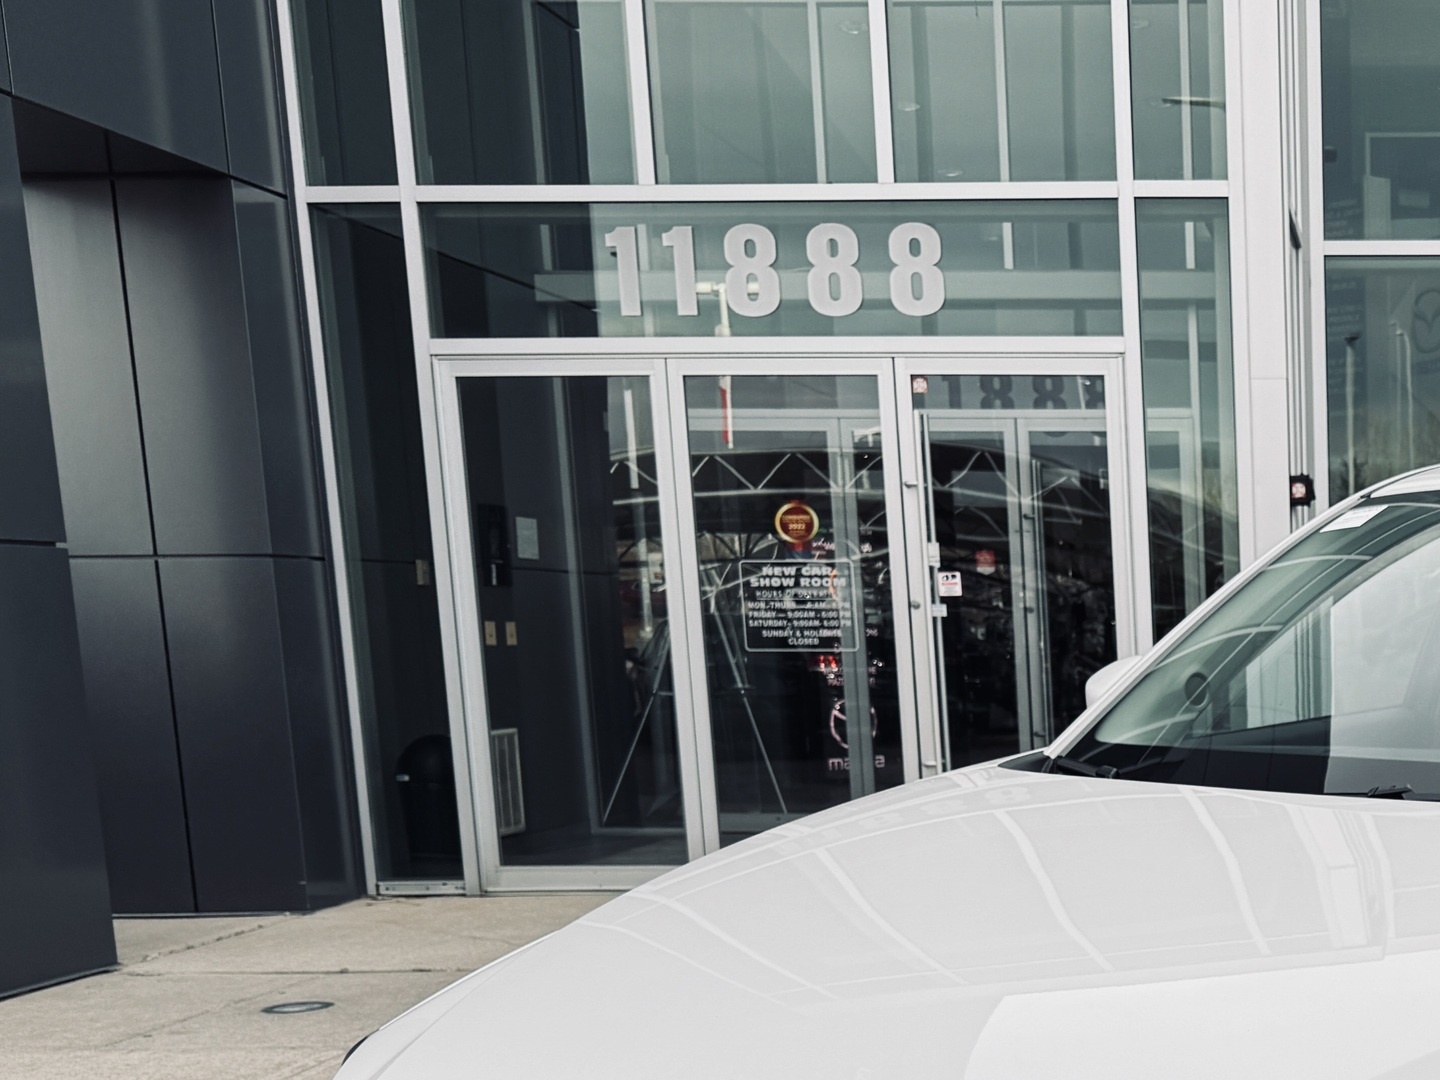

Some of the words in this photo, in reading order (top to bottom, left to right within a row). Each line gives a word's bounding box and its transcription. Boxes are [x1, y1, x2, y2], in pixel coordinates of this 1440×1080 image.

[605, 222, 945, 317] 11888
[762, 566, 797, 576] NEW
[801, 566, 833, 576] CAR
[750, 577, 795, 587] SHOW
[799, 577, 846, 587] ROOM
[756, 590, 782, 598] HOURS
[762, 629, 793, 637] SUNDAY
